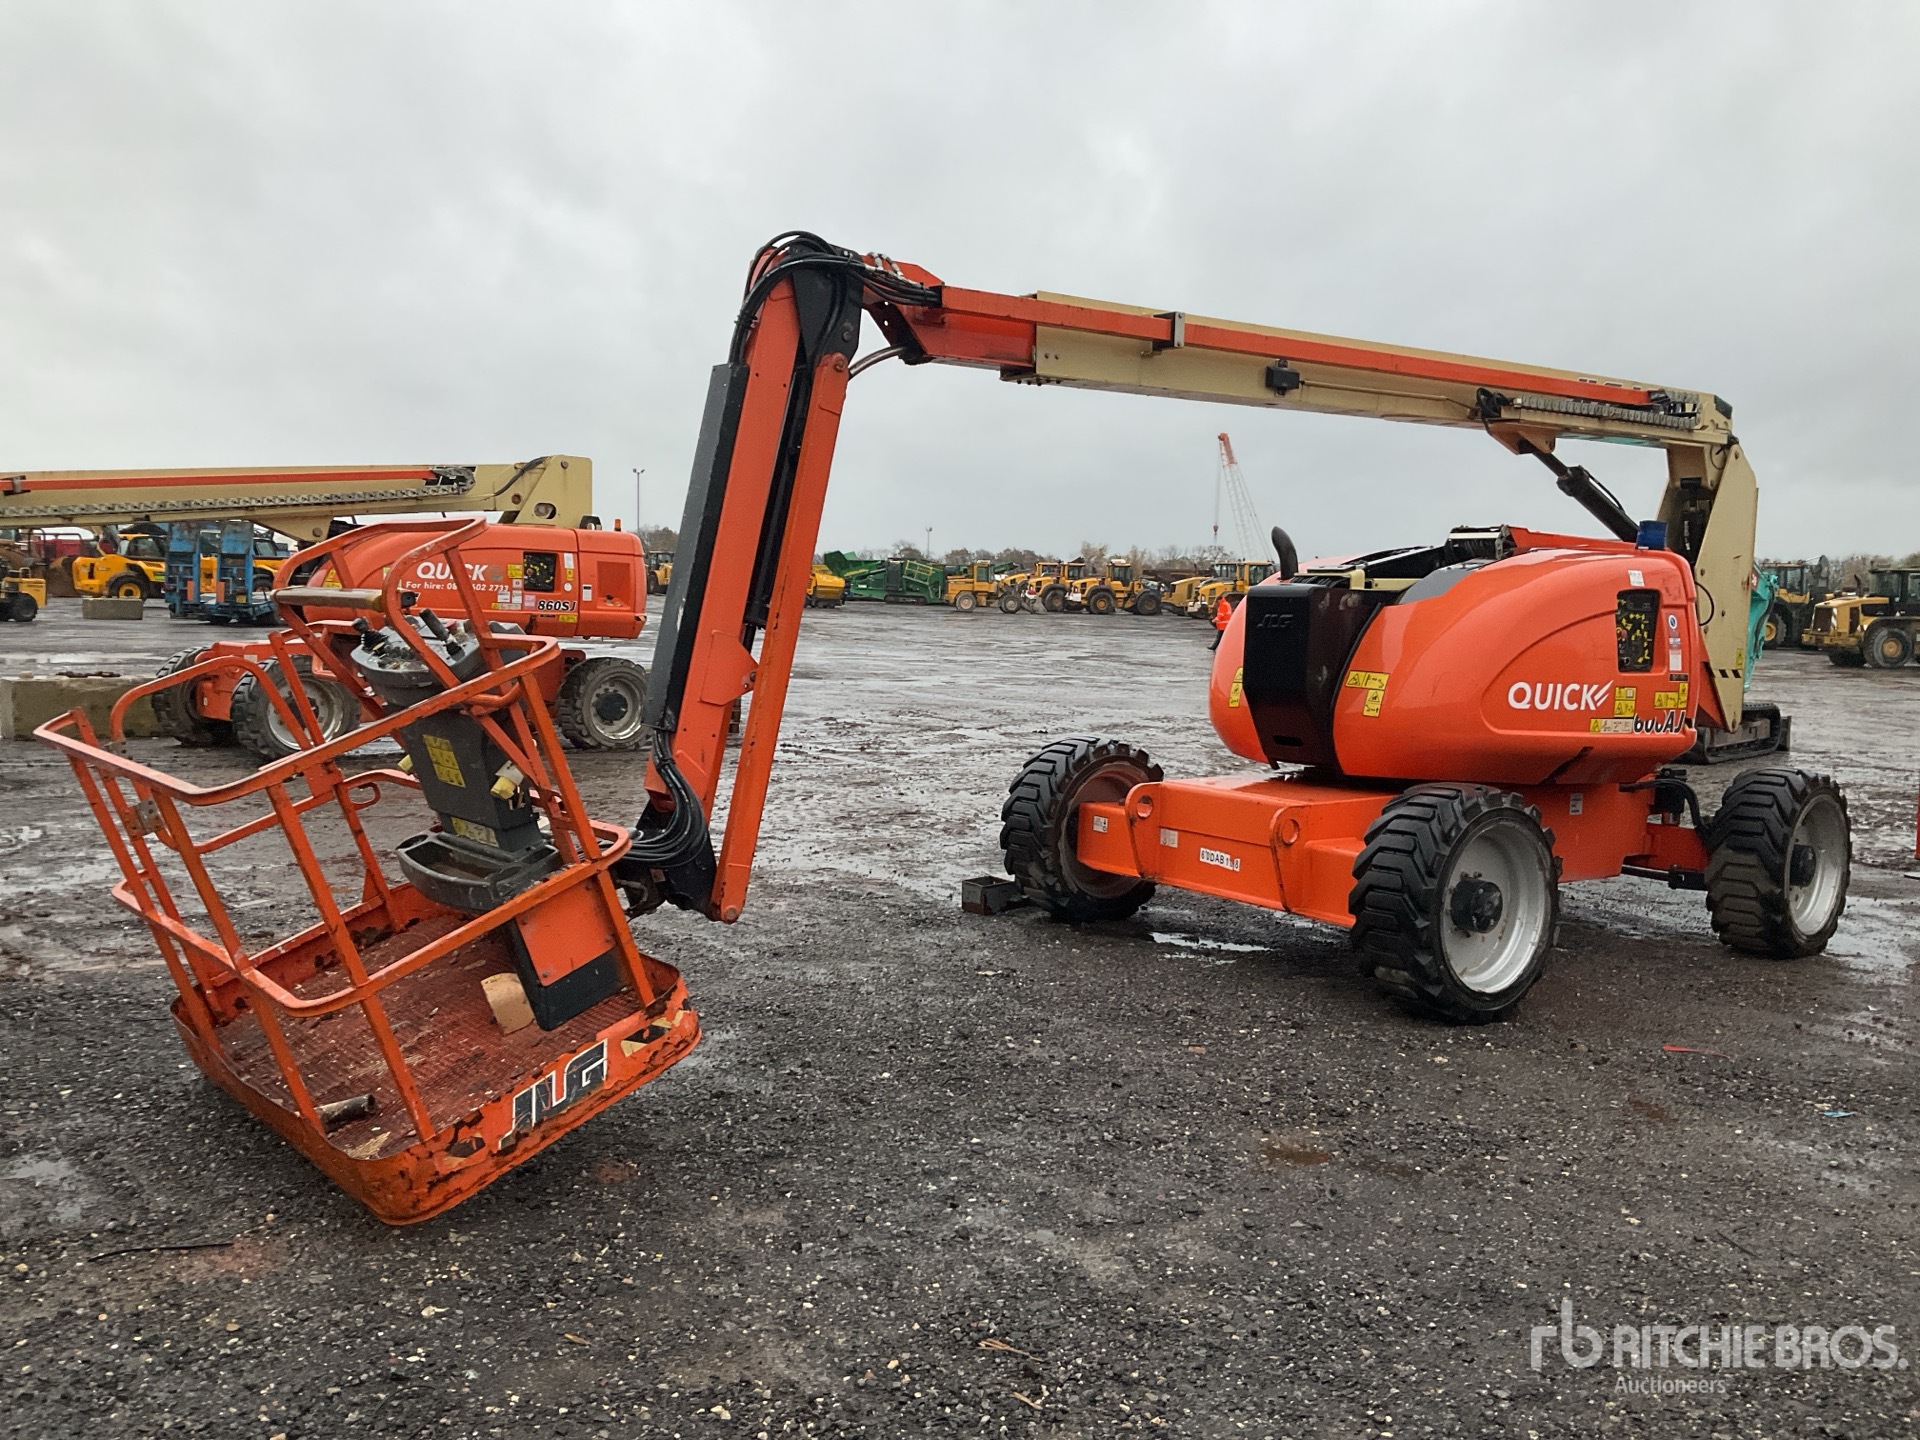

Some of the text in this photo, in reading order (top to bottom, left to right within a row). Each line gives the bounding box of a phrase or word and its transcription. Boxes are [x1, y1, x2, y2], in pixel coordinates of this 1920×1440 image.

[416, 561, 489, 582] QUK
[405, 581, 422, 590] For
[423, 582, 445, 591] hire:
[537, 600, 577, 612] 860SJ
[1507, 681, 1600, 711] QUICK
